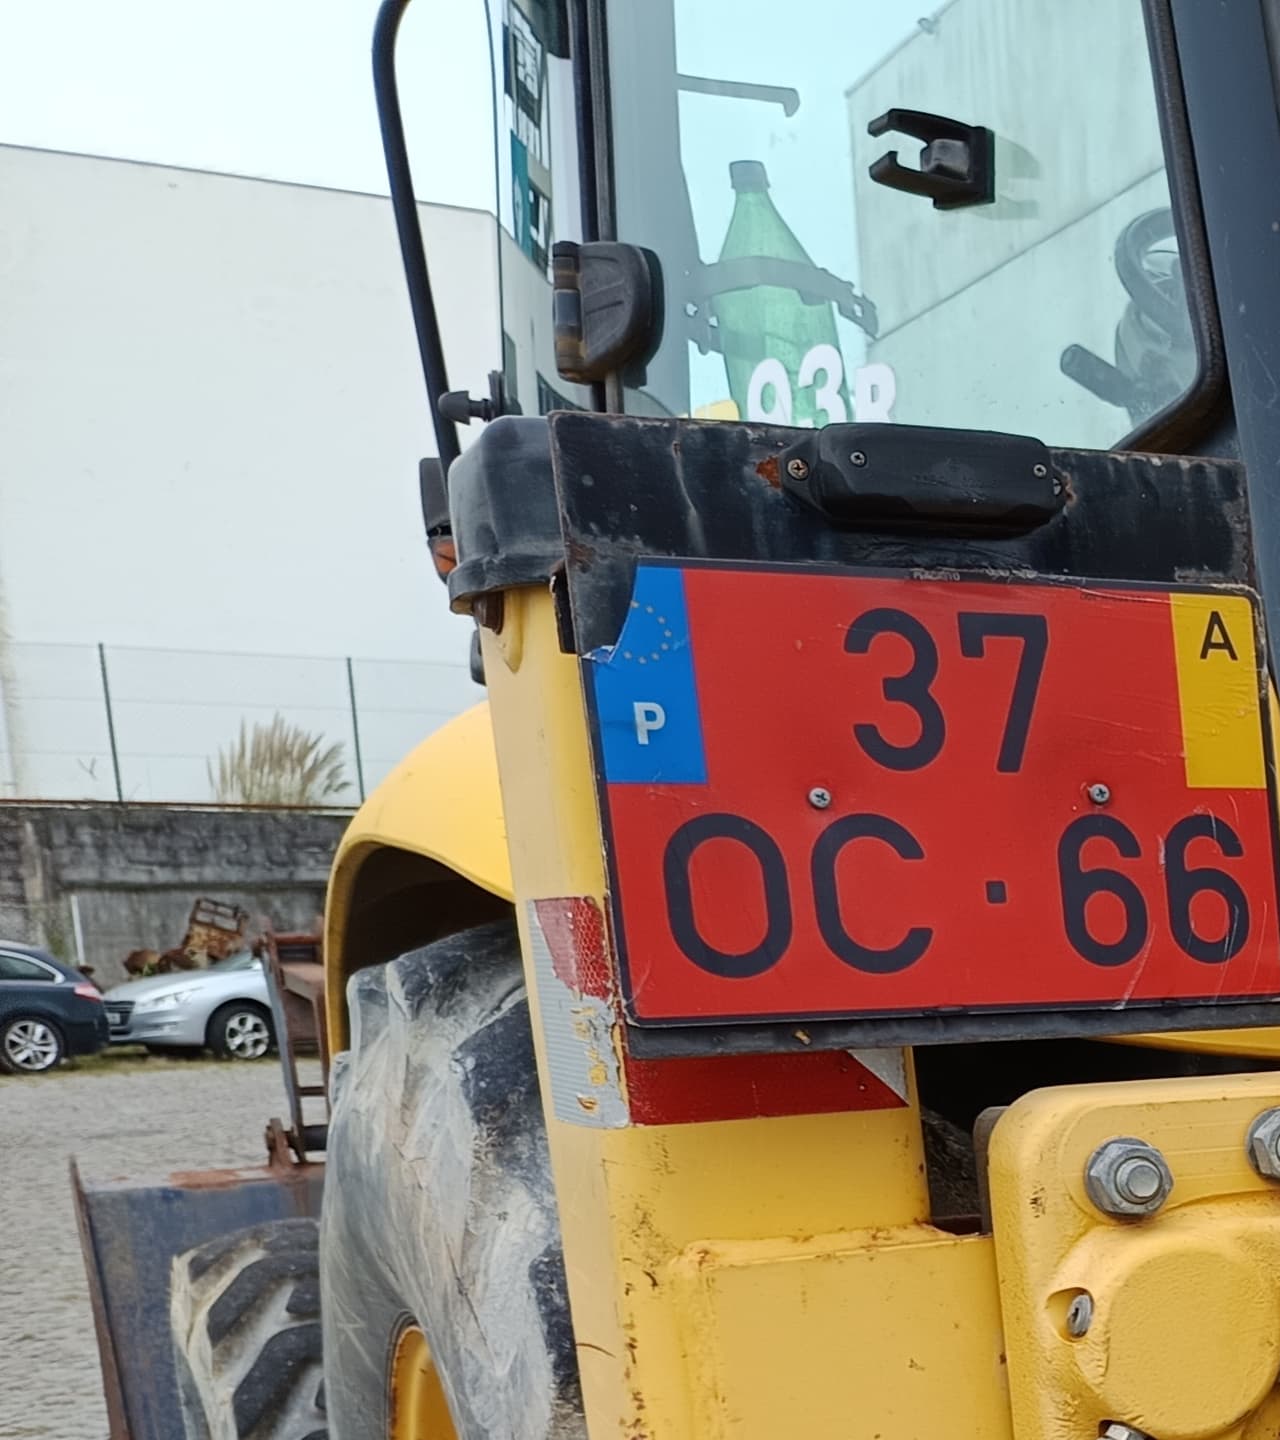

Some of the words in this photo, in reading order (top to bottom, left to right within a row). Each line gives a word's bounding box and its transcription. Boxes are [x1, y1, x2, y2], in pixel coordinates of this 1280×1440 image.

[843, 606, 1049, 773] 37
[1198, 610, 1239, 662] A
[633, 702, 665, 745] P
[662, 813, 934, 980] OC
[1056, 814, 1250, 968] 66
